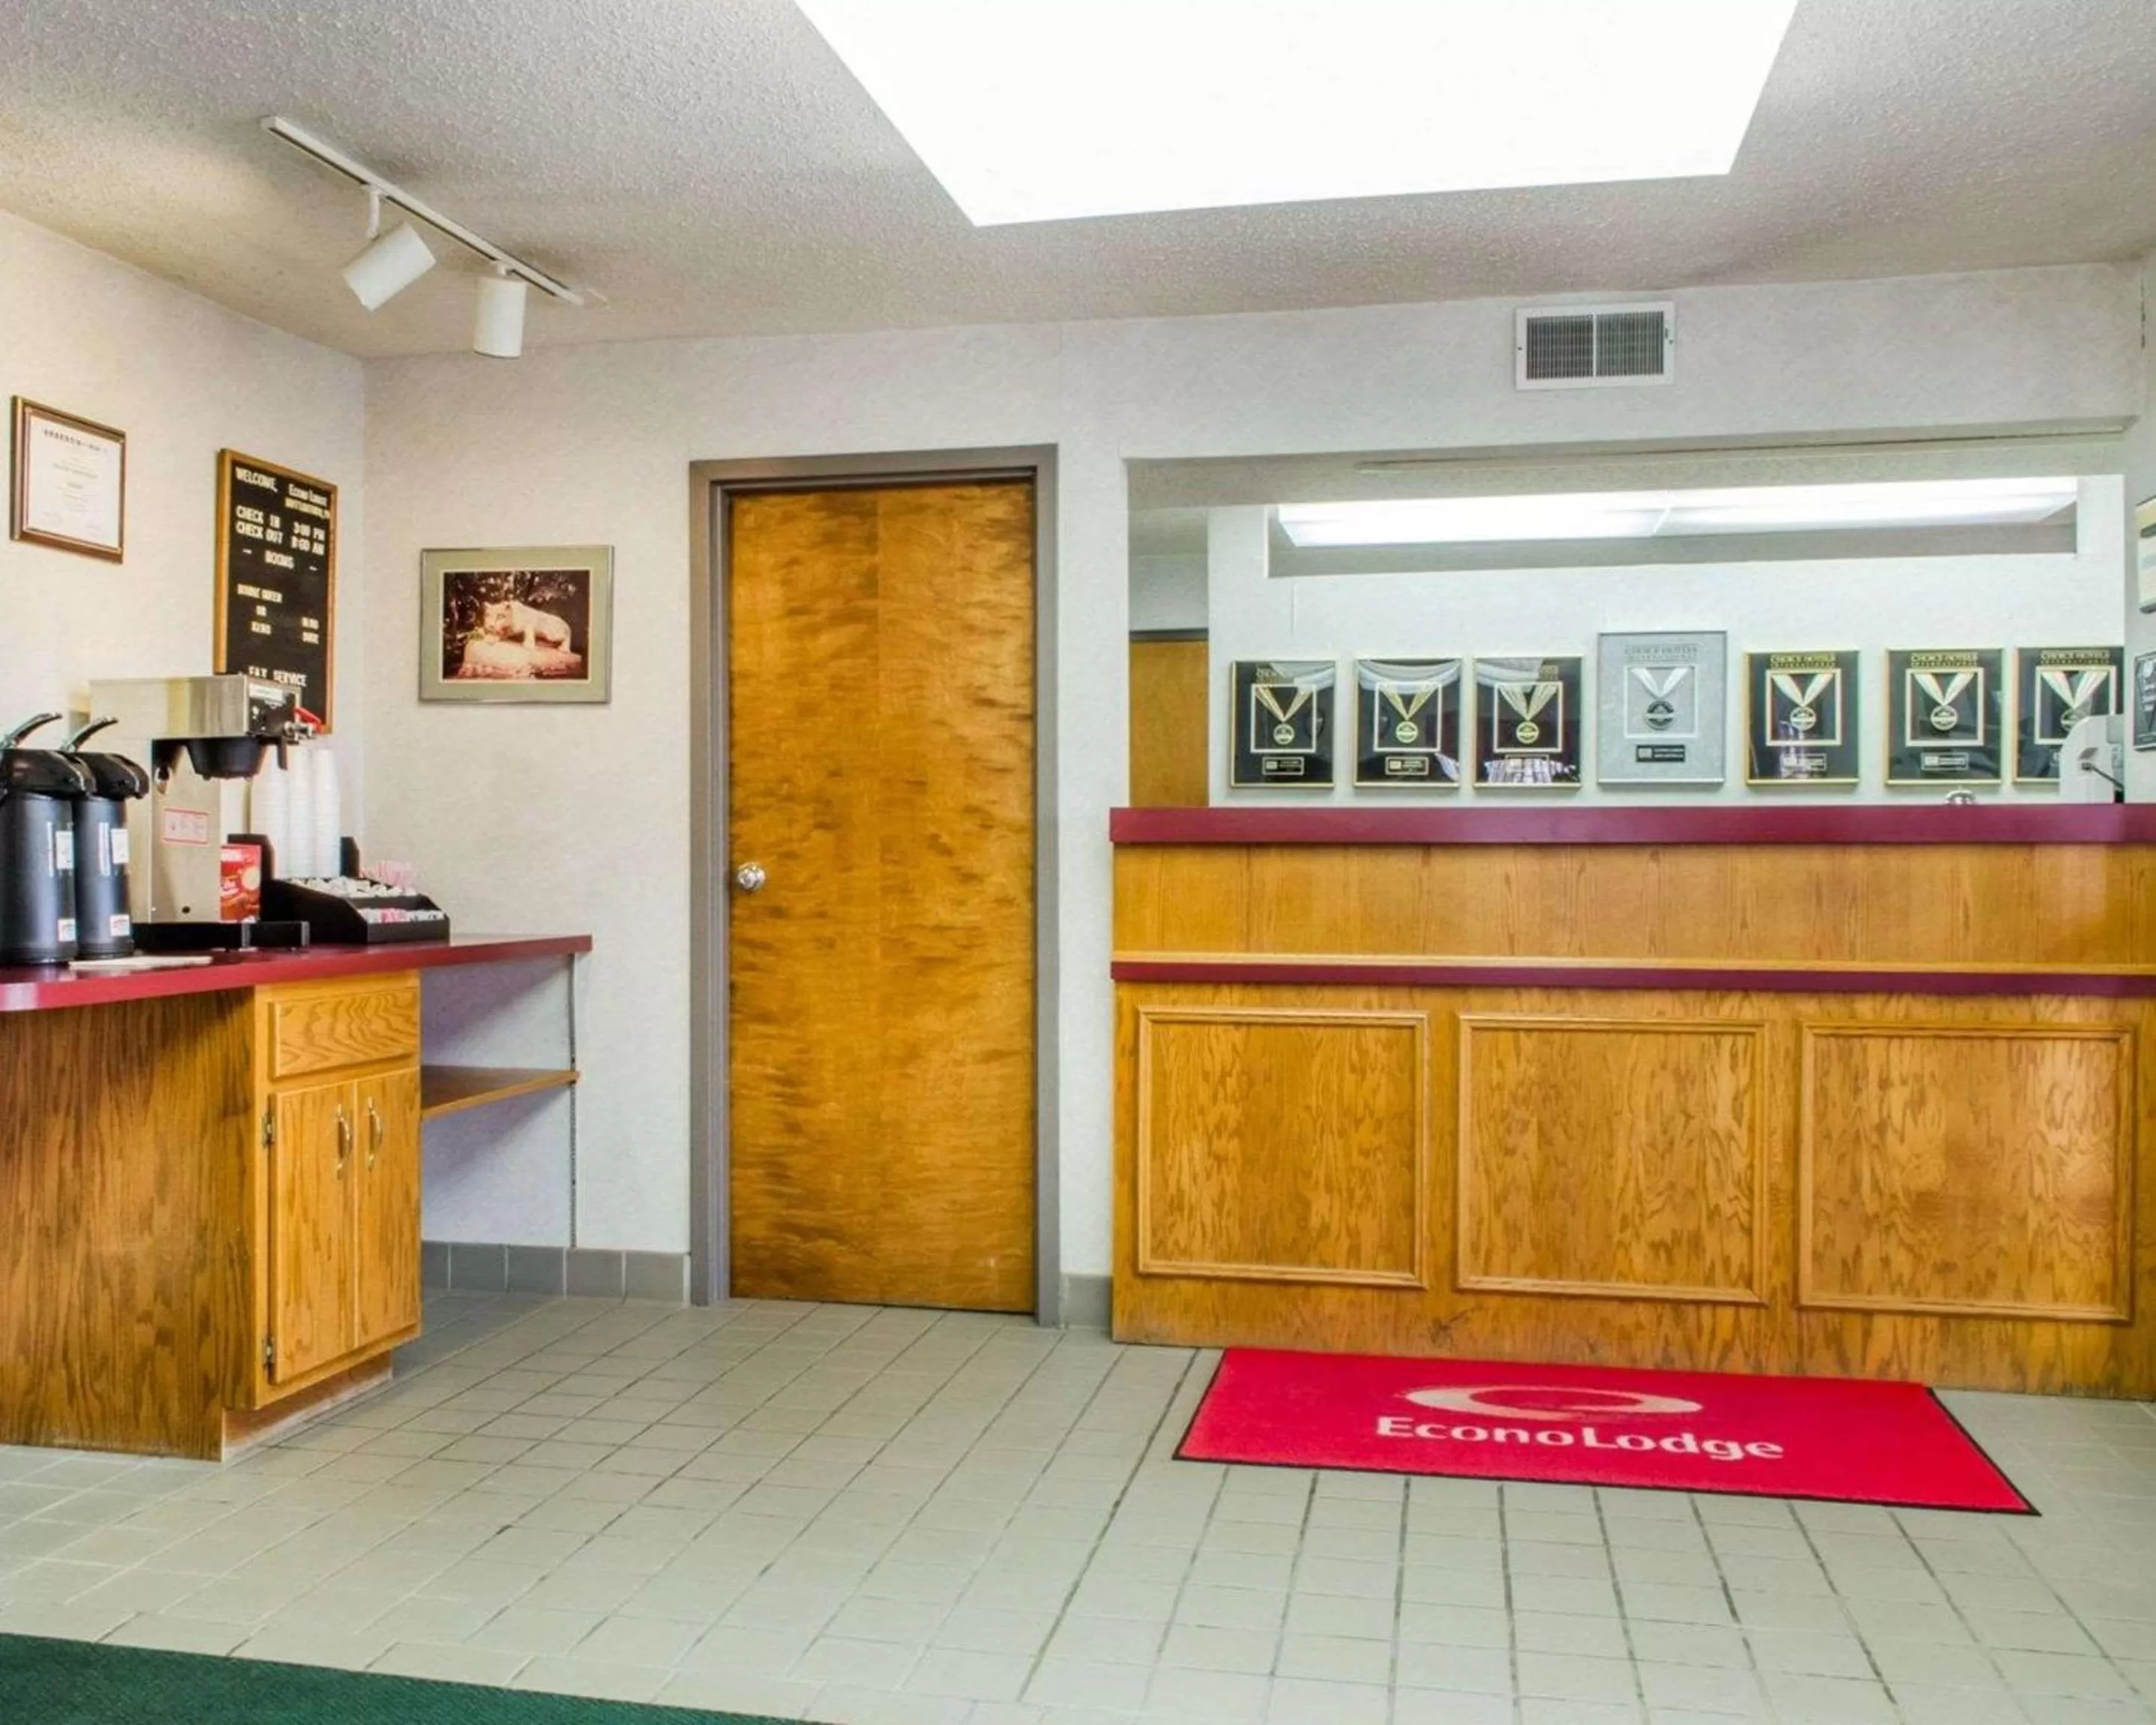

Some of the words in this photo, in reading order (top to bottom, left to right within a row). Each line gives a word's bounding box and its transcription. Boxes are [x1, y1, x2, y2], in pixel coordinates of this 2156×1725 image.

[236, 505, 264, 524] CHECK
[270, 514, 281, 529] IN
[312, 527, 325, 541] PM
[236, 520, 264, 539] CHECK
[266, 528, 283, 545] OUT
[312, 541, 324, 556] AM
[272, 669, 307, 687] SERVICE
